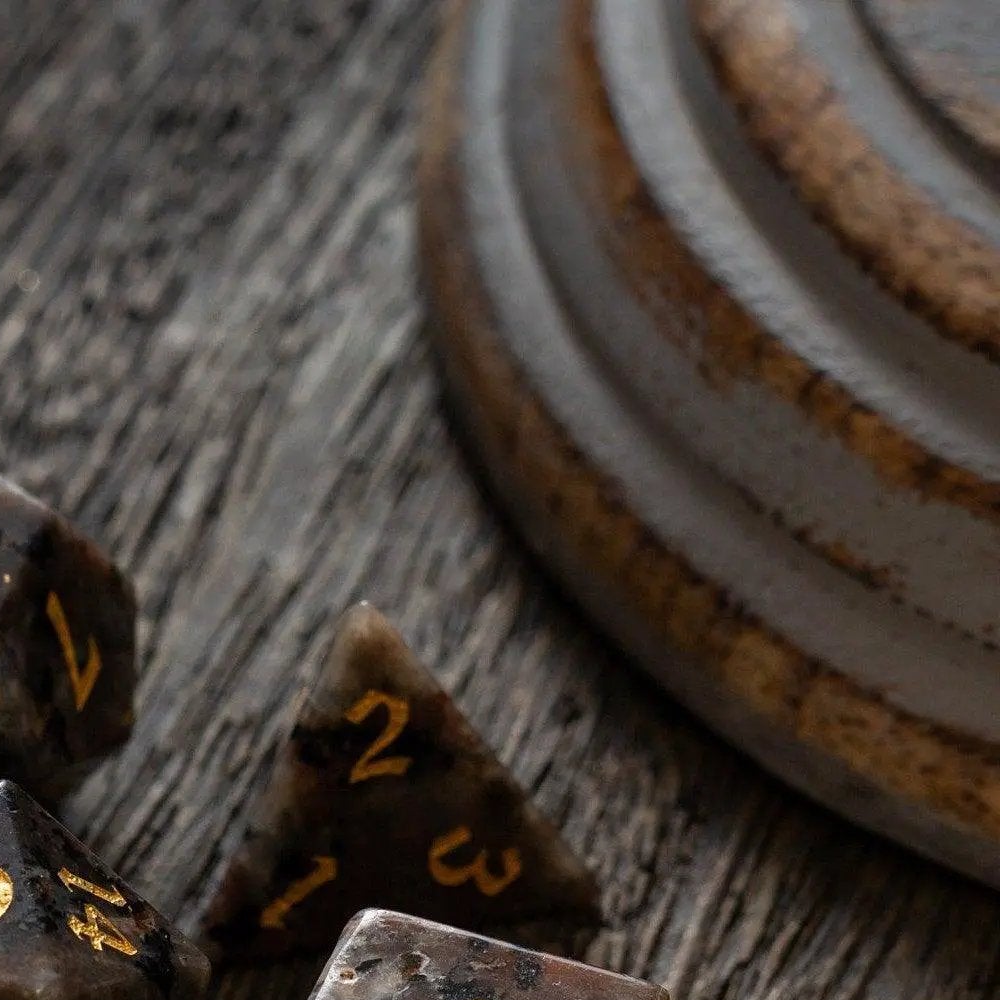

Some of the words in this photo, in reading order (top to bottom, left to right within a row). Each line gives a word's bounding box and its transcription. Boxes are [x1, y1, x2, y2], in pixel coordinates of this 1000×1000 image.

[346, 689, 413, 784] 2
[260, 856, 338, 928] 1
[428, 826, 522, 897] 3
